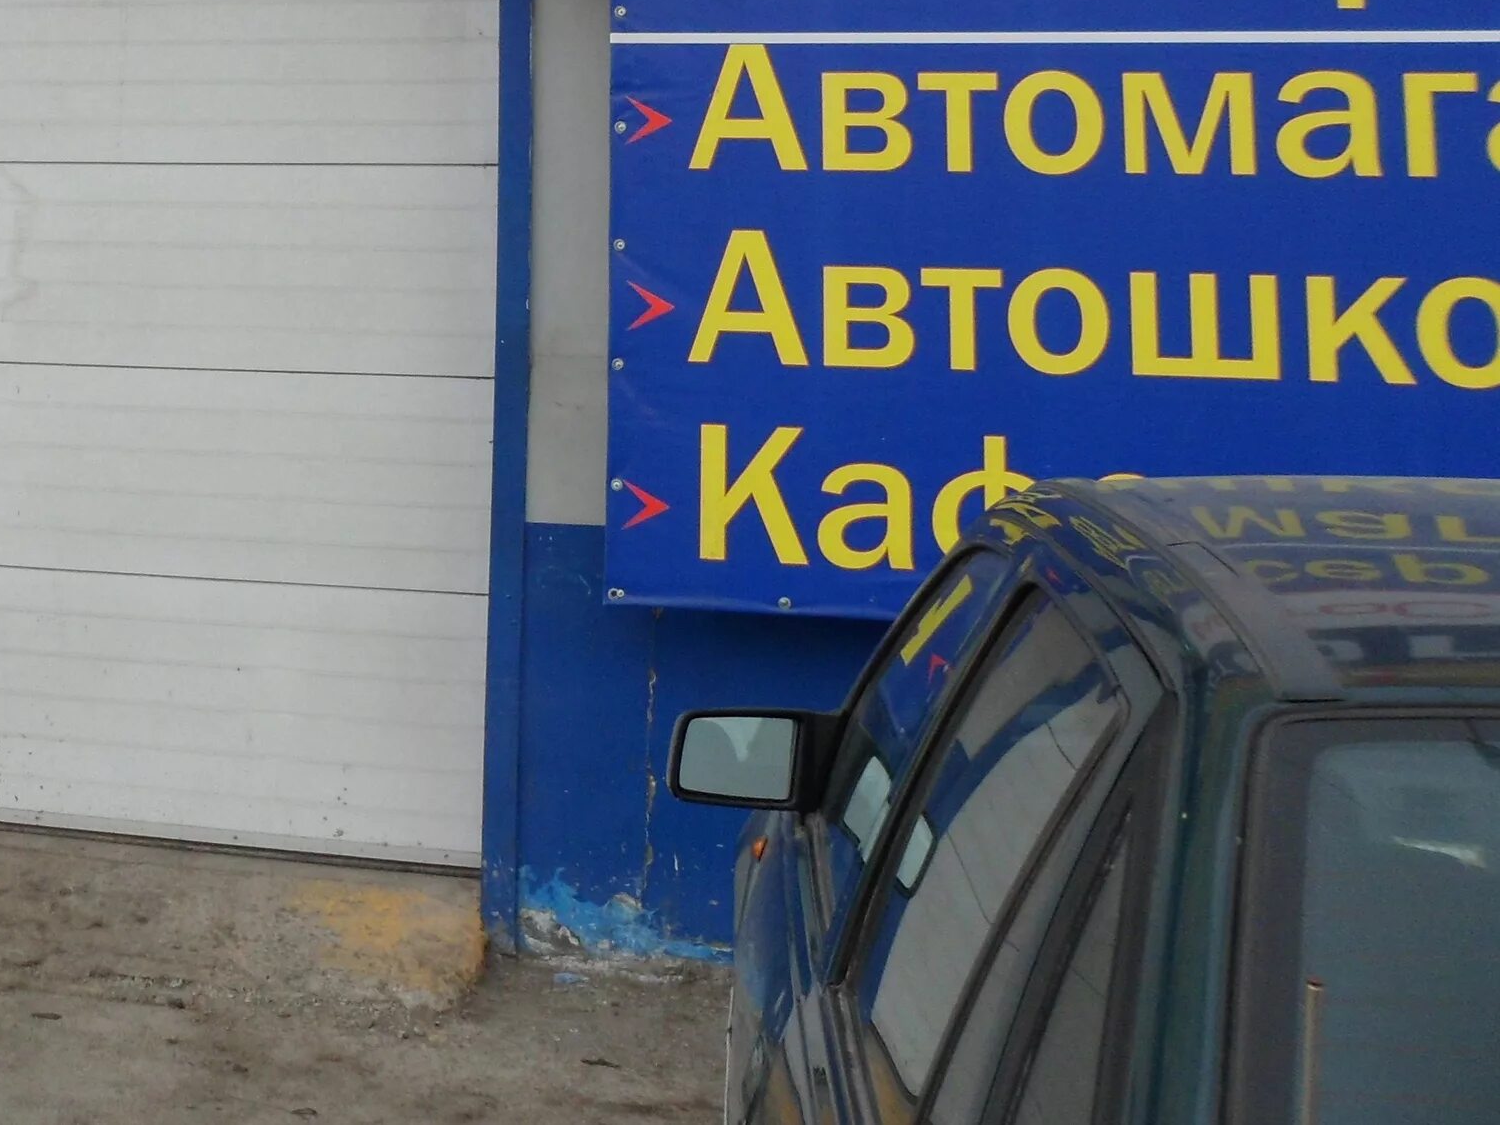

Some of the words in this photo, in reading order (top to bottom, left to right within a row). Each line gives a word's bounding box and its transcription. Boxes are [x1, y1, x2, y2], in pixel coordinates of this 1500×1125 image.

[687, 43, 1500, 179] Автомаг
[687, 228, 1500, 390] Автошко
[698, 423, 1147, 571] Каф
